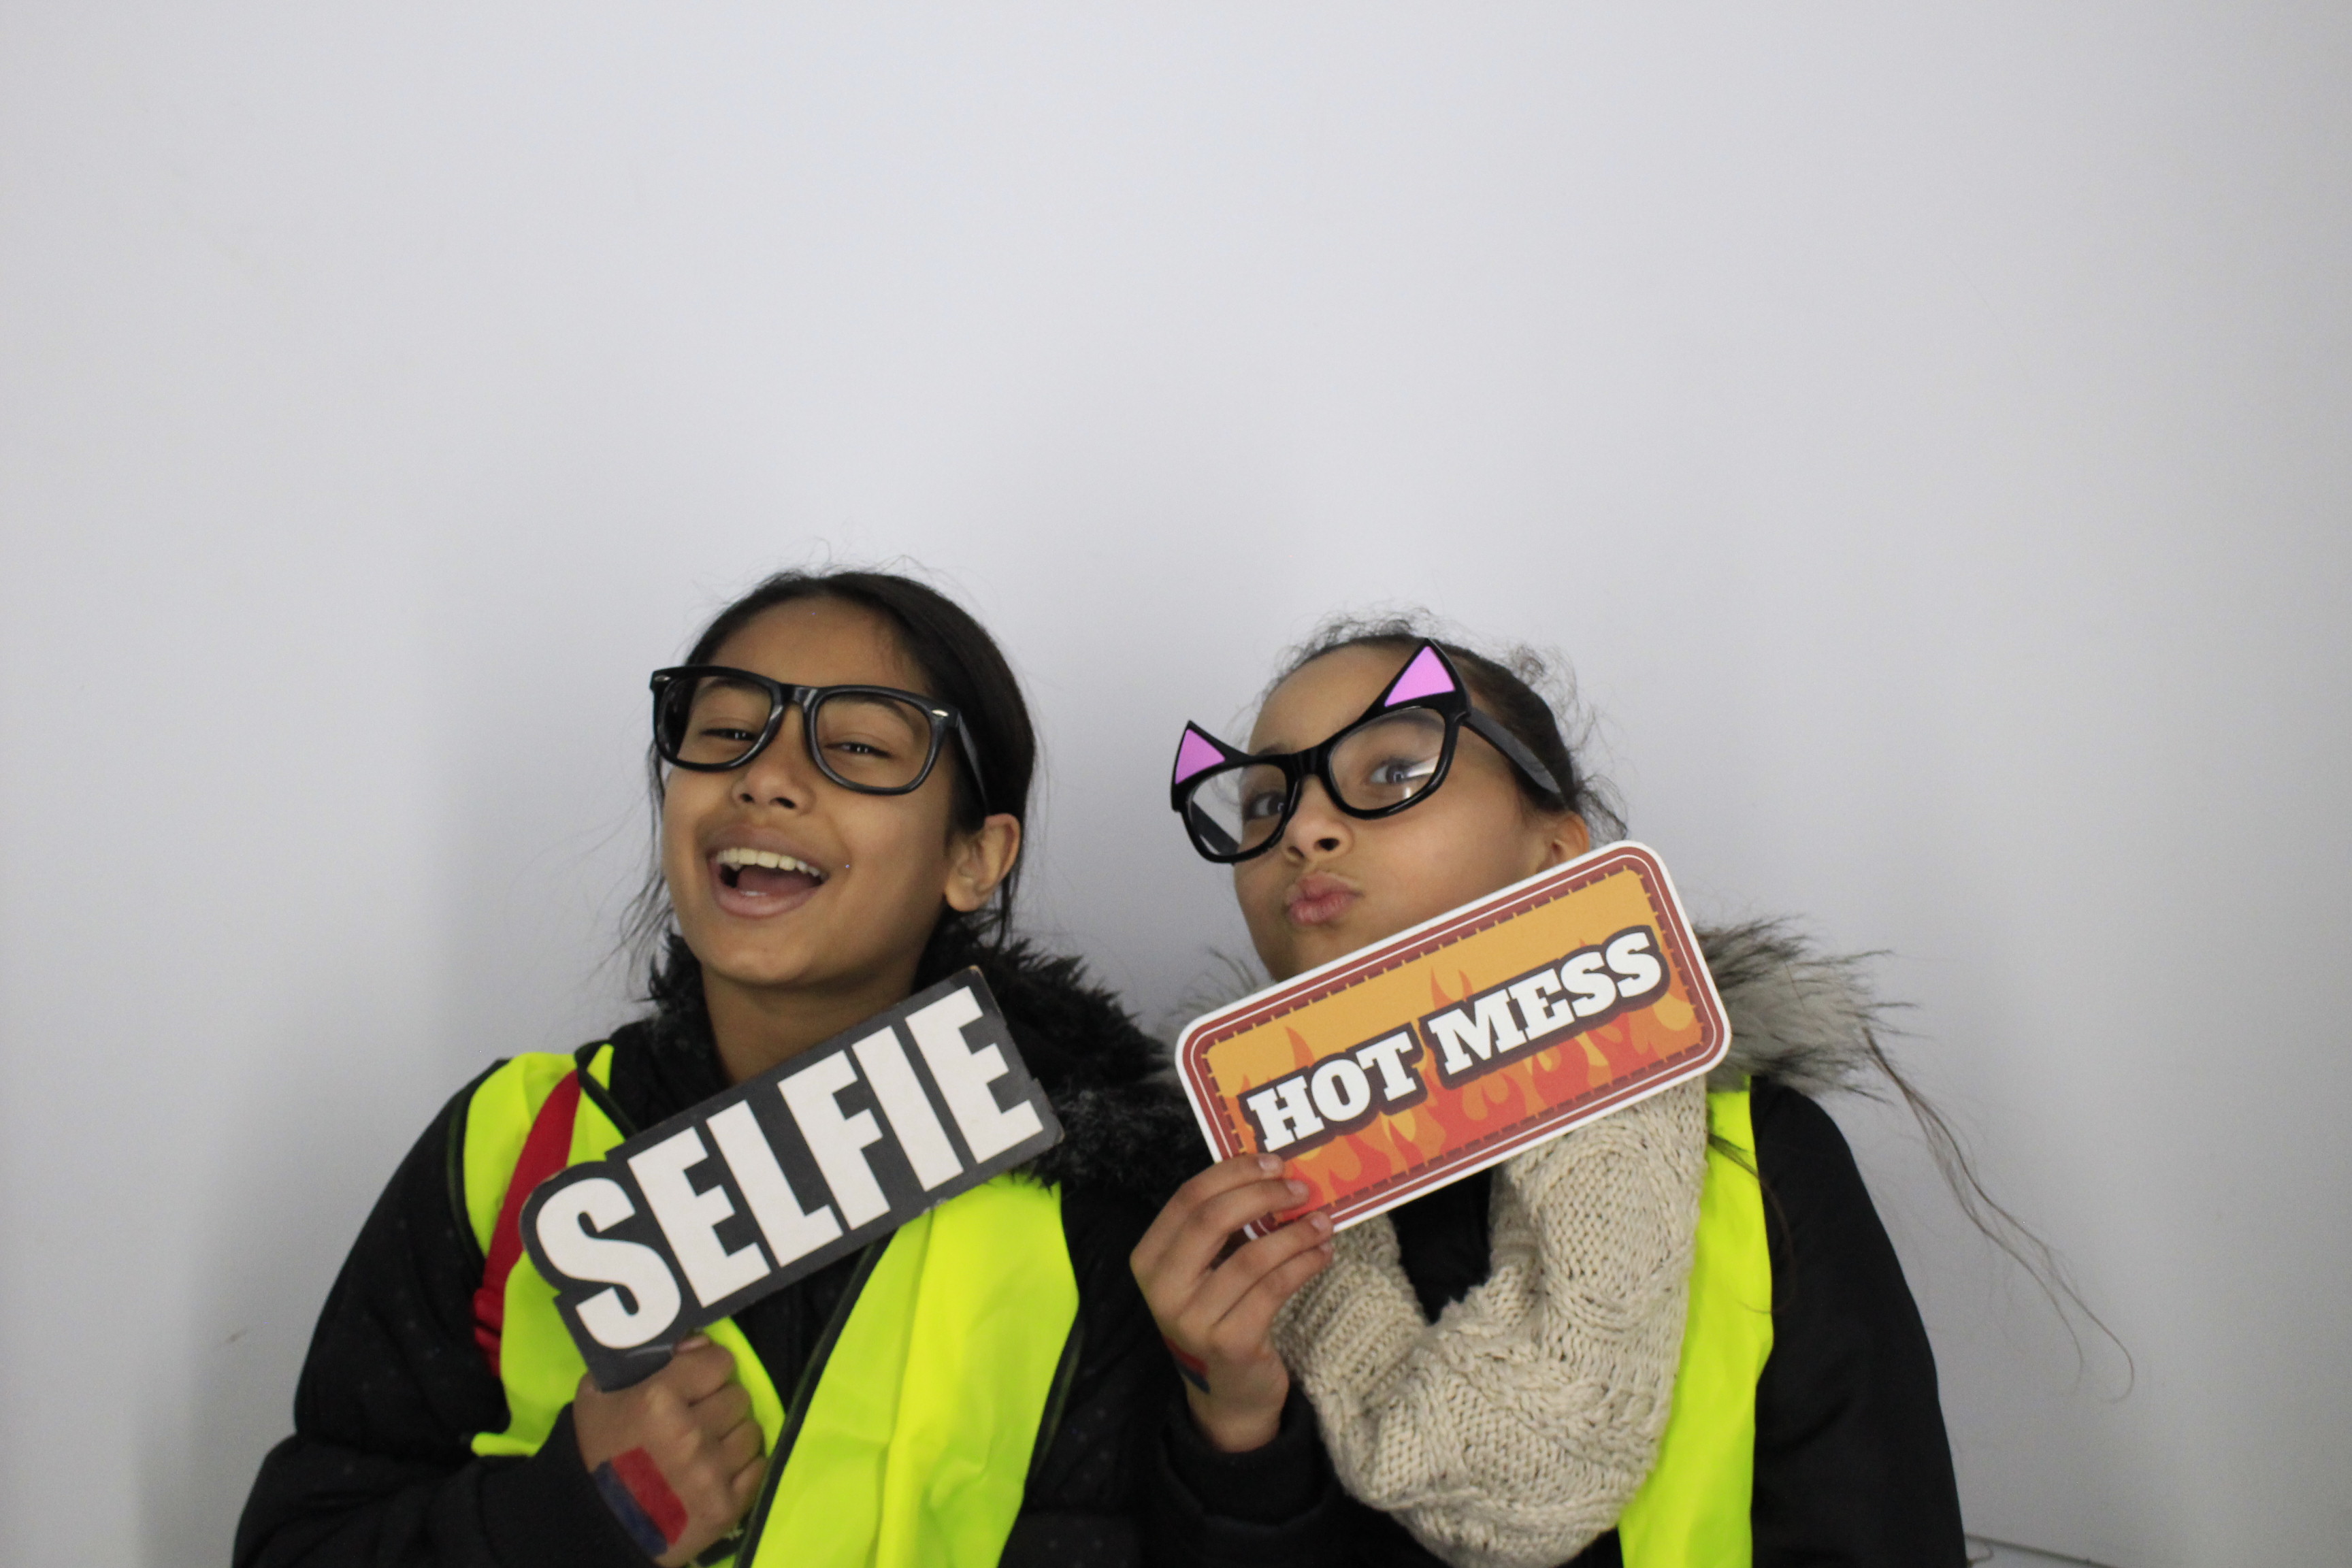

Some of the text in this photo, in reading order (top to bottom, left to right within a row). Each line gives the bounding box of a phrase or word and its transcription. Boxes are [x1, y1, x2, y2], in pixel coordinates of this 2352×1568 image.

[536, 985, 1045, 1350] SELFIE
[1246, 930, 1663, 1153] HOT MESS
